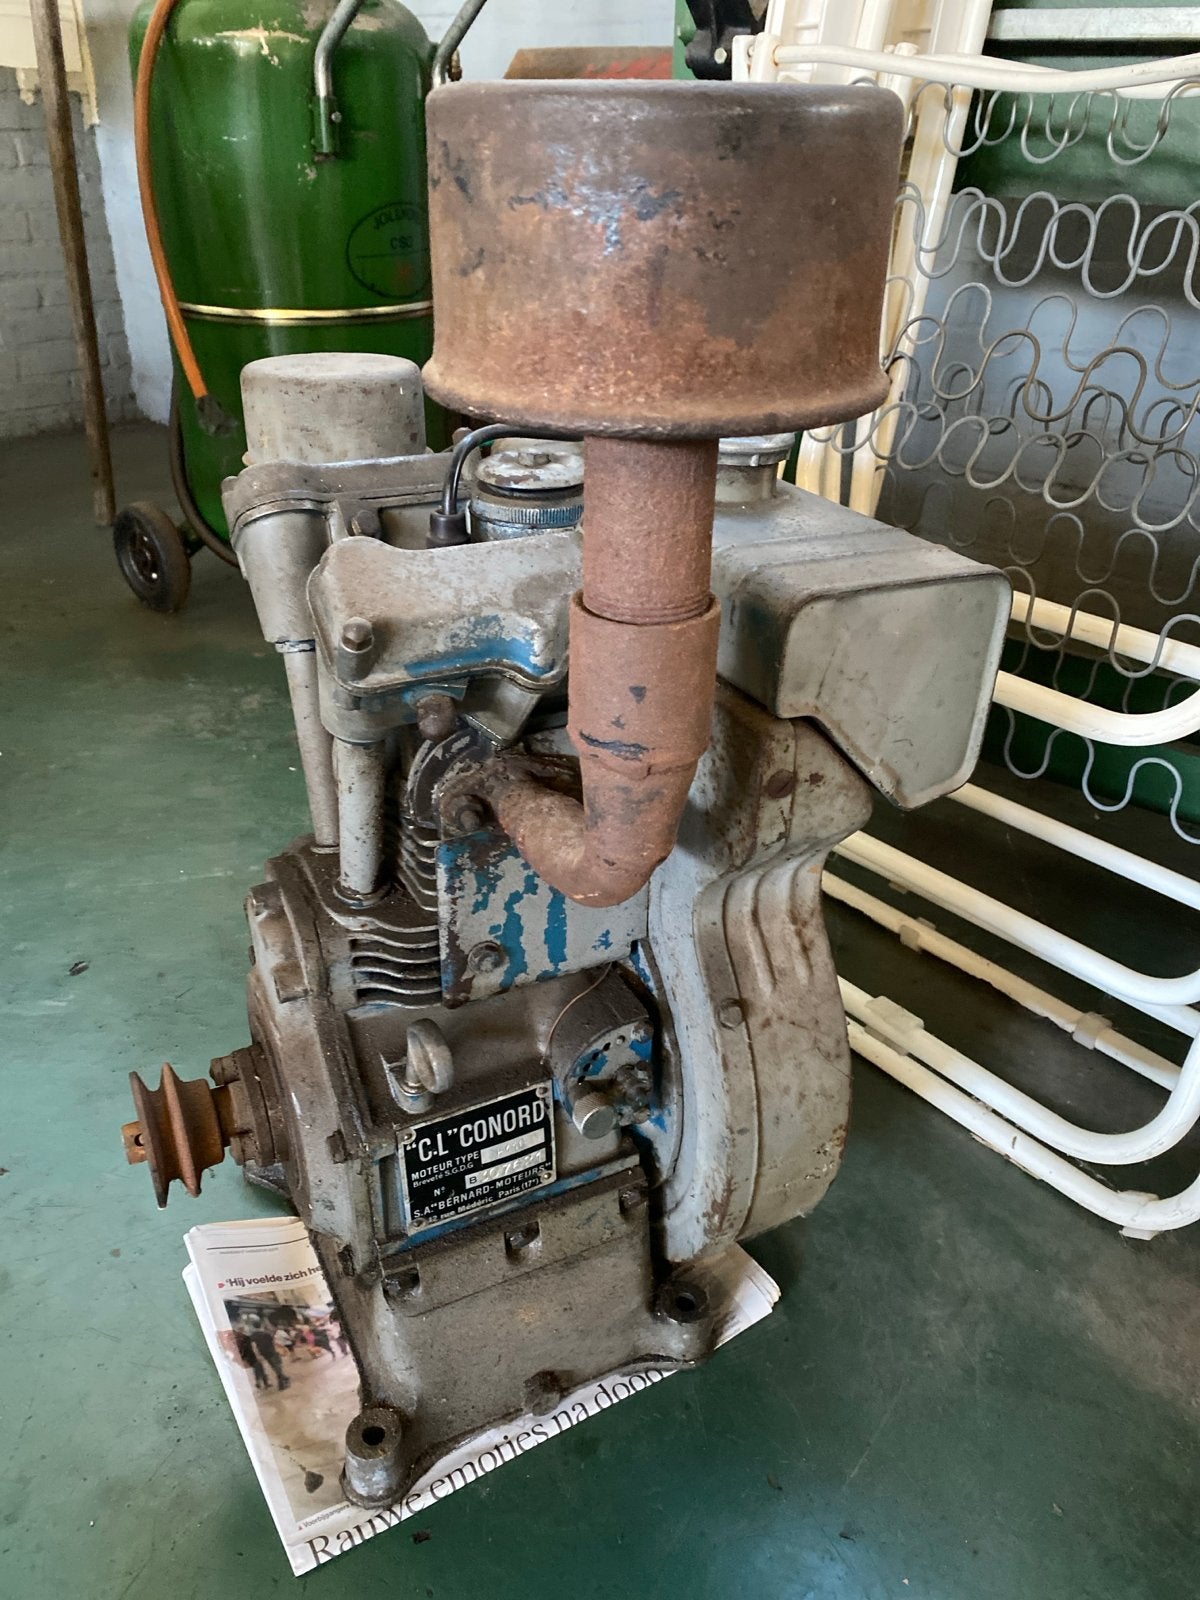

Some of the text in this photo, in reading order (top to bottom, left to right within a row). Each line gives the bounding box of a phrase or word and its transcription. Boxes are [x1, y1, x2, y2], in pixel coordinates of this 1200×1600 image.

[459, 1100, 545, 1148] CONORD
[411, 1151, 480, 1181] MOTEUR TYPE
[412, 1172, 444, 1188] Breveté
[440, 1210, 456, 1219] rue
[457, 1196, 494, 1213] Médéric
[498, 1186, 521, 1198] Paris
[245, 1274, 283, 1285] voelde
[283, 1270, 308, 1281] zich
[305, 1493, 424, 1565] Rauwe
[430, 1424, 549, 1500] emoties
[552, 1402, 590, 1432] na
